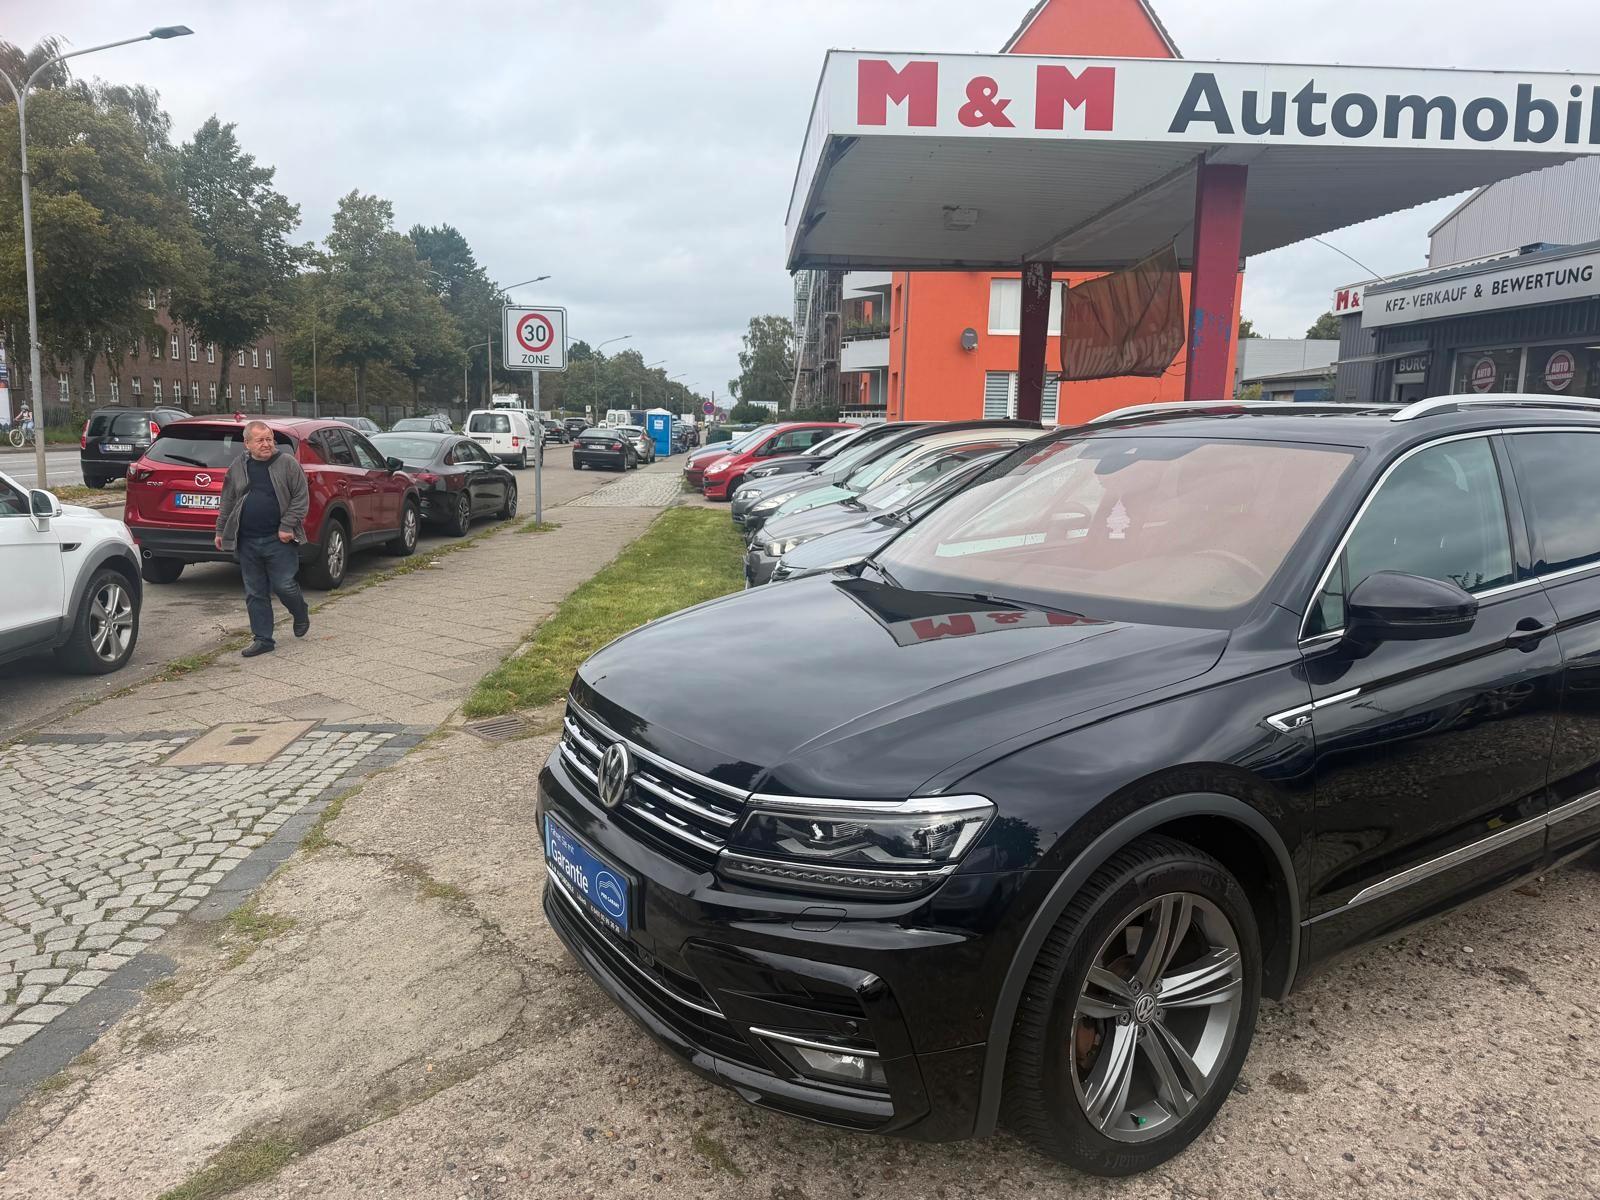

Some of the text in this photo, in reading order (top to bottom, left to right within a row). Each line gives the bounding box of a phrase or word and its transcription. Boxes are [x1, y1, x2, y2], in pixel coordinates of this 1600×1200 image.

[858, 59, 938, 127] M
[957, 76, 1015, 128] &
[1034, 65, 1116, 131] M
[1385, 265, 1594, 312] KFZ-VERKAUF & BEWERTUNG
[1336, 290, 1360, 311] M &
[524, 324, 546, 342] 30
[521, 354, 550, 364] ZONE
[1551, 361, 1569, 373] AUTO
[181, 495, 194, 505] OH
[199, 495, 213, 506] HZ
[551, 839, 589, 894] Garantie
